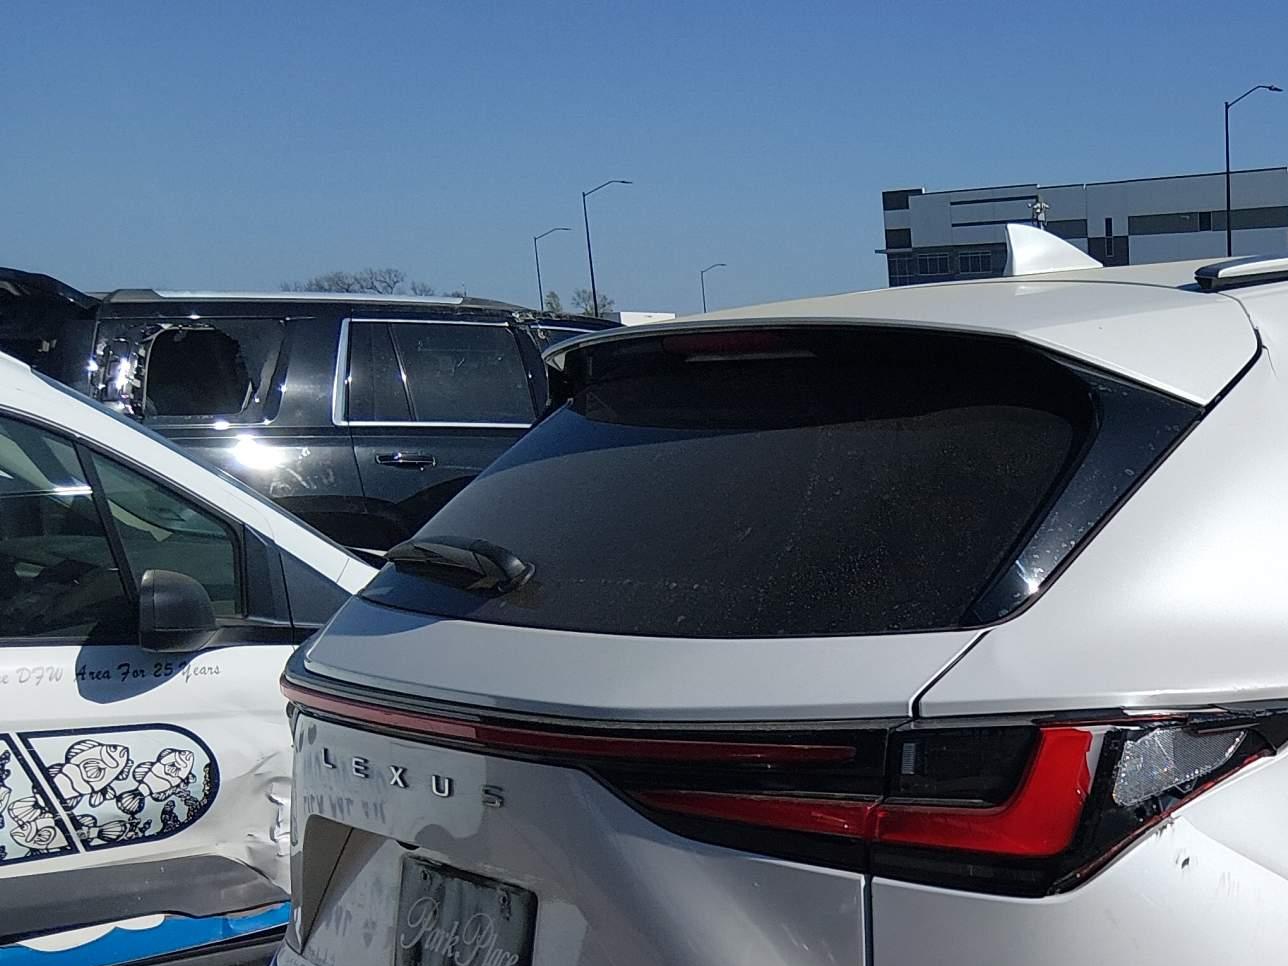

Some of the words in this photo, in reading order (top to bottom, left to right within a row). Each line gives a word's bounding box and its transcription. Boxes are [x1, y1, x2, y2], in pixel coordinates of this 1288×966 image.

[15, 667, 63, 686] DFW
[75, 664, 111, 682] Area
[117, 663, 146, 682] For
[153, 662, 173, 677] 25
[180, 661, 221, 684] Years
[321, 747, 504, 808] LEXUS
[400, 896, 459, 958] Park
